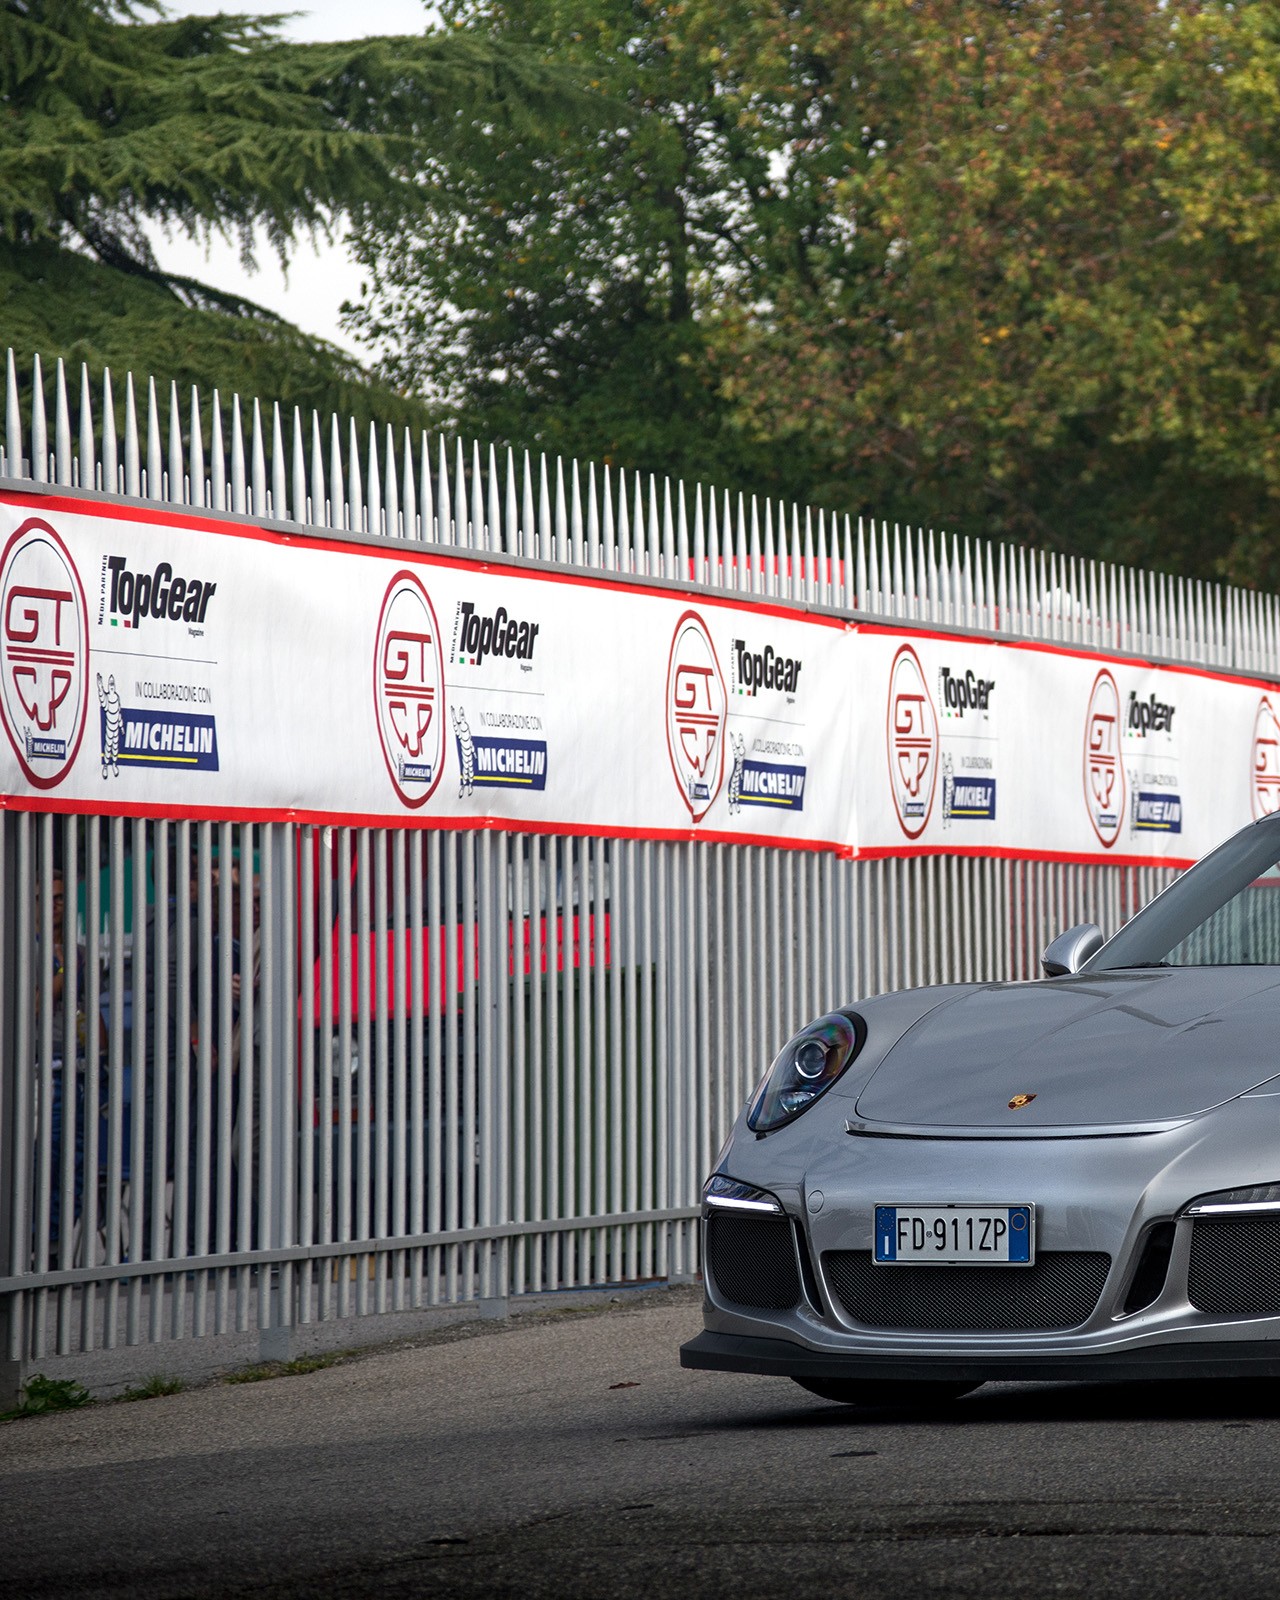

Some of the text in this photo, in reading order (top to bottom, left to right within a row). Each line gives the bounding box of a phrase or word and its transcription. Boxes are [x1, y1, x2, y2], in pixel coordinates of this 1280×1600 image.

[108, 556, 217, 629] TopGear
[5, 585, 73, 647] GT
[460, 602, 539, 666] TopGear
[383, 630, 432, 683] GT
[735, 639, 802, 697] TopGear
[135, 681, 212, 703] IN COLLABORAZIONE CON
[674, 664, 714, 711] GT
[895, 693, 926, 734] GT
[33, 742, 65, 754] MICHELIN
[124, 721, 213, 754] MICHELIN
[477, 747, 545, 775] MICHELIN
[742, 769, 804, 797] MICHELIN
[898, 1217, 1007, 1251] FD 911ZP
